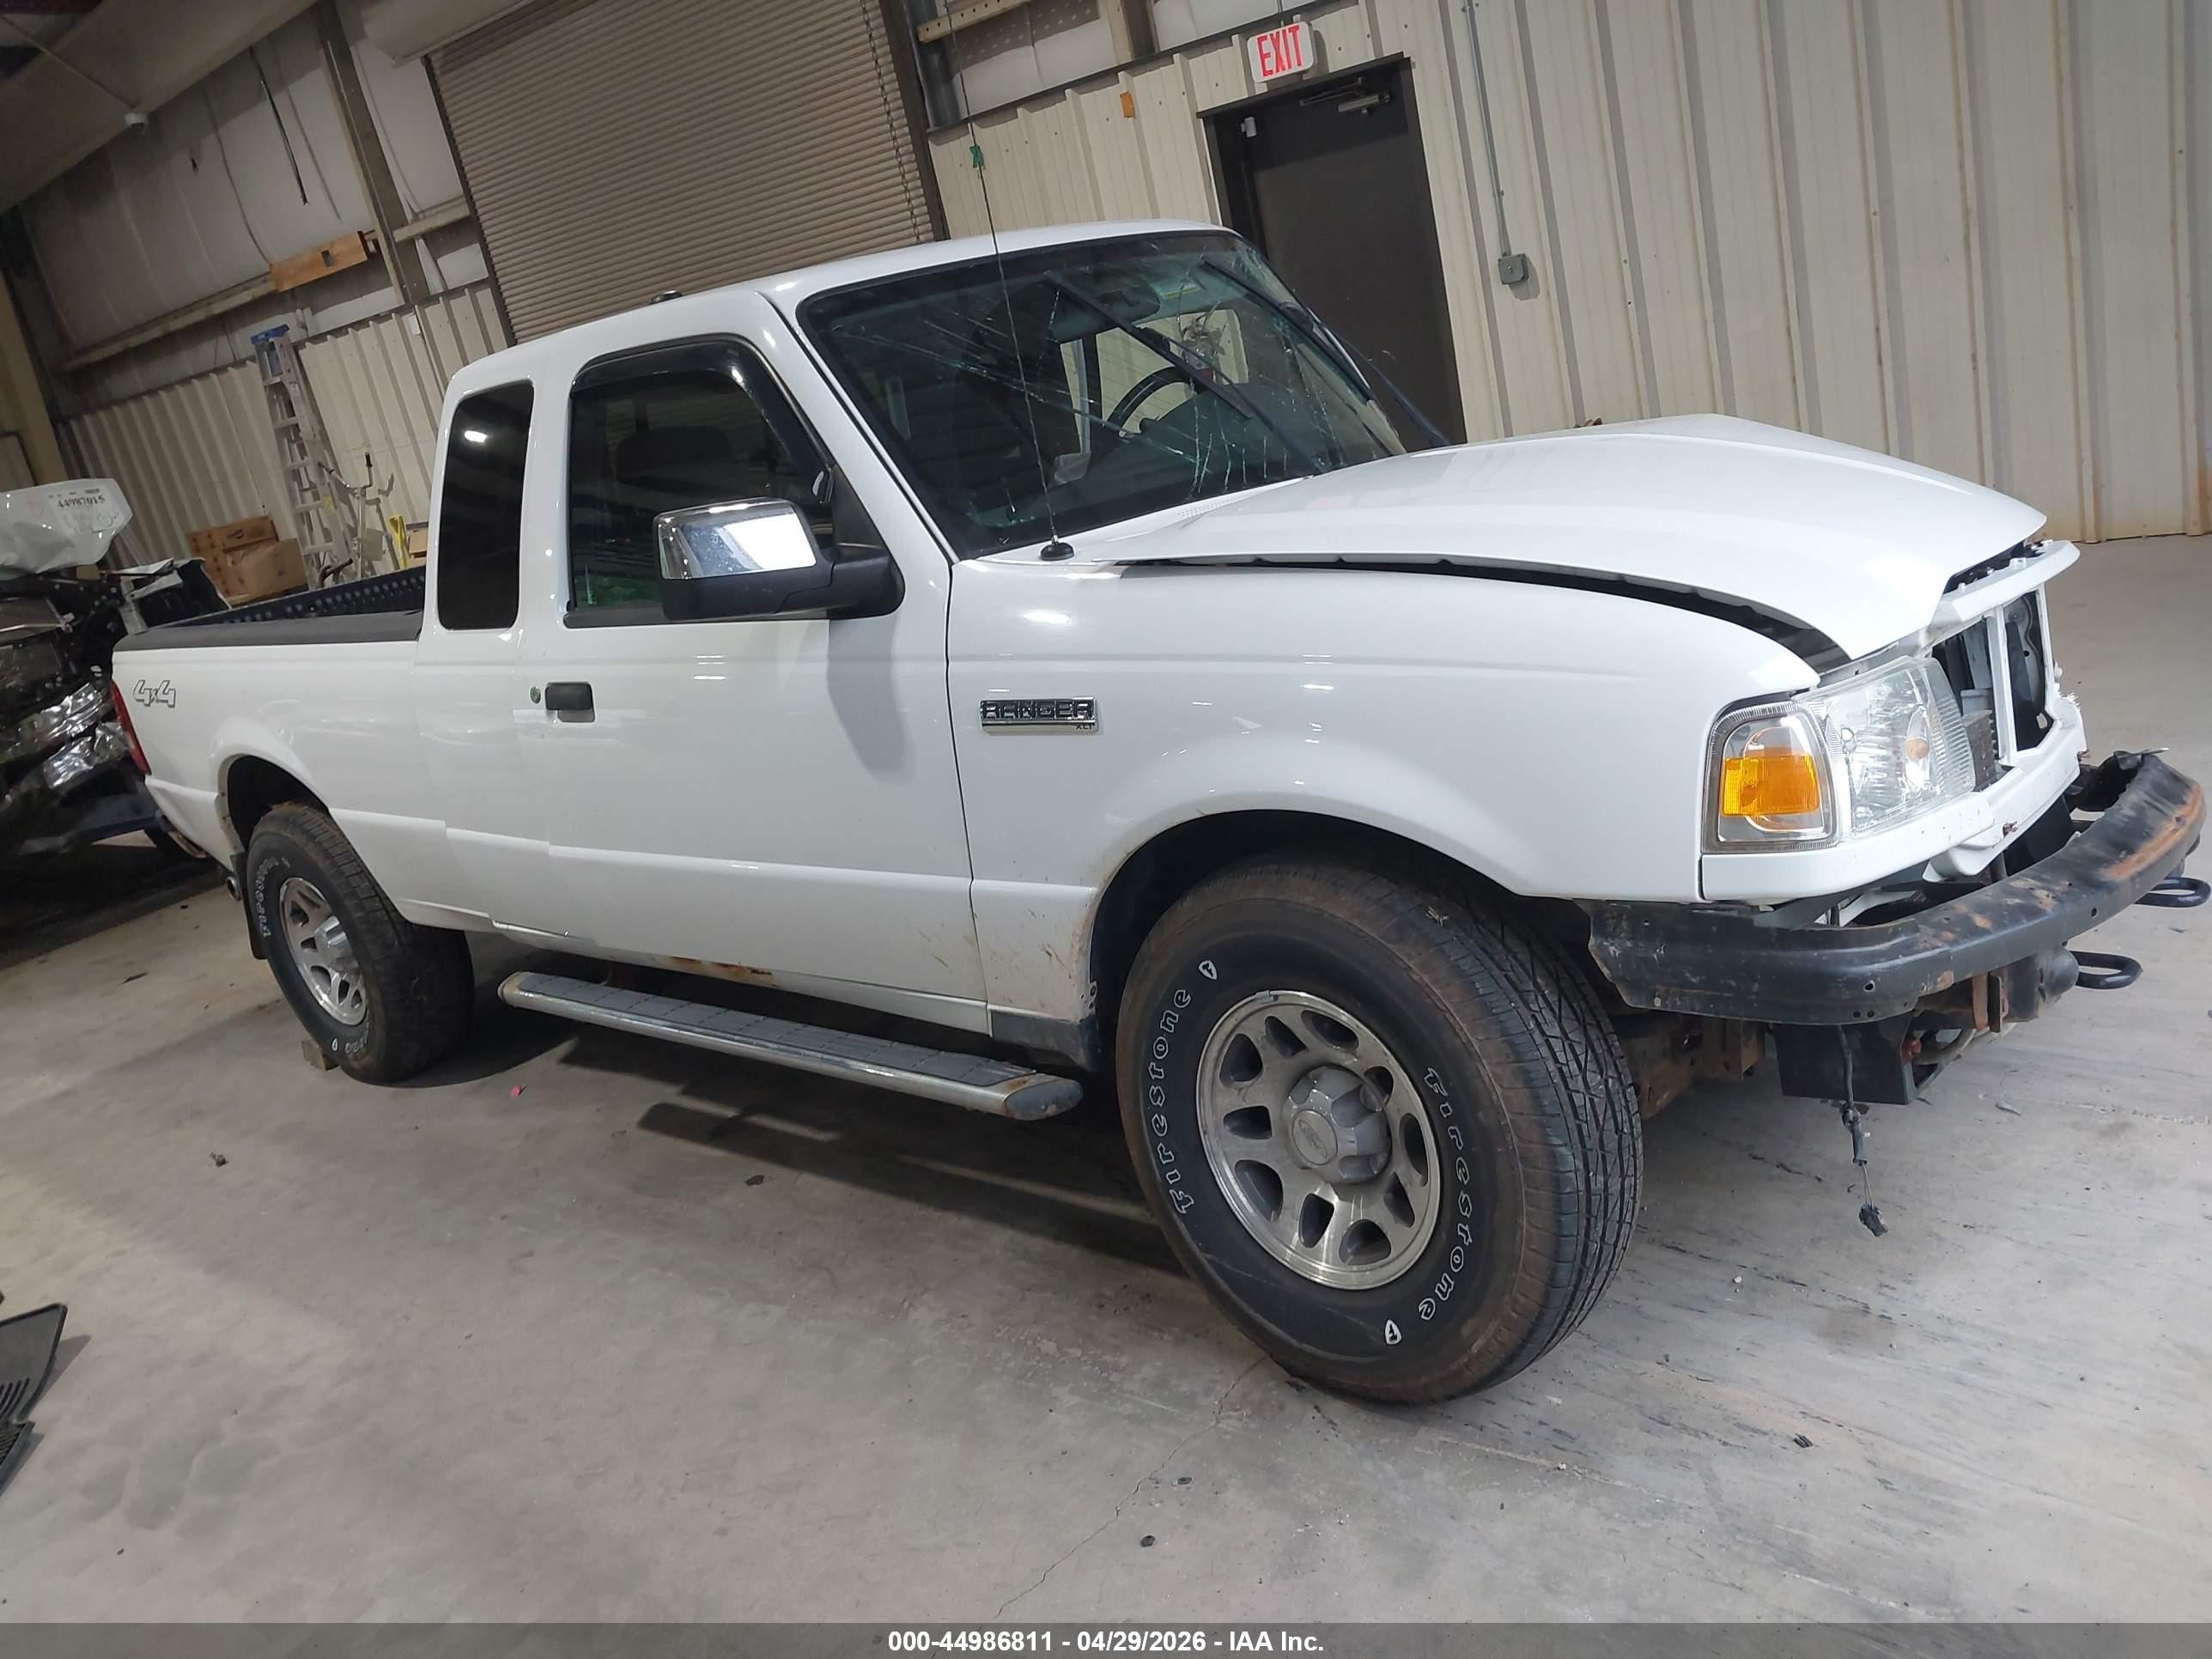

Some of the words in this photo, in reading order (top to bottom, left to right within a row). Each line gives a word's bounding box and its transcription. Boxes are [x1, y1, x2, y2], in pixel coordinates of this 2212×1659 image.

[1257, 25, 1302, 76] EXIT
[133, 680, 176, 708] 4x4
[980, 700, 1094, 720] RANGER
[1149, 989, 1194, 1215] Firestone
[1419, 1067, 1472, 1320] Firestone
